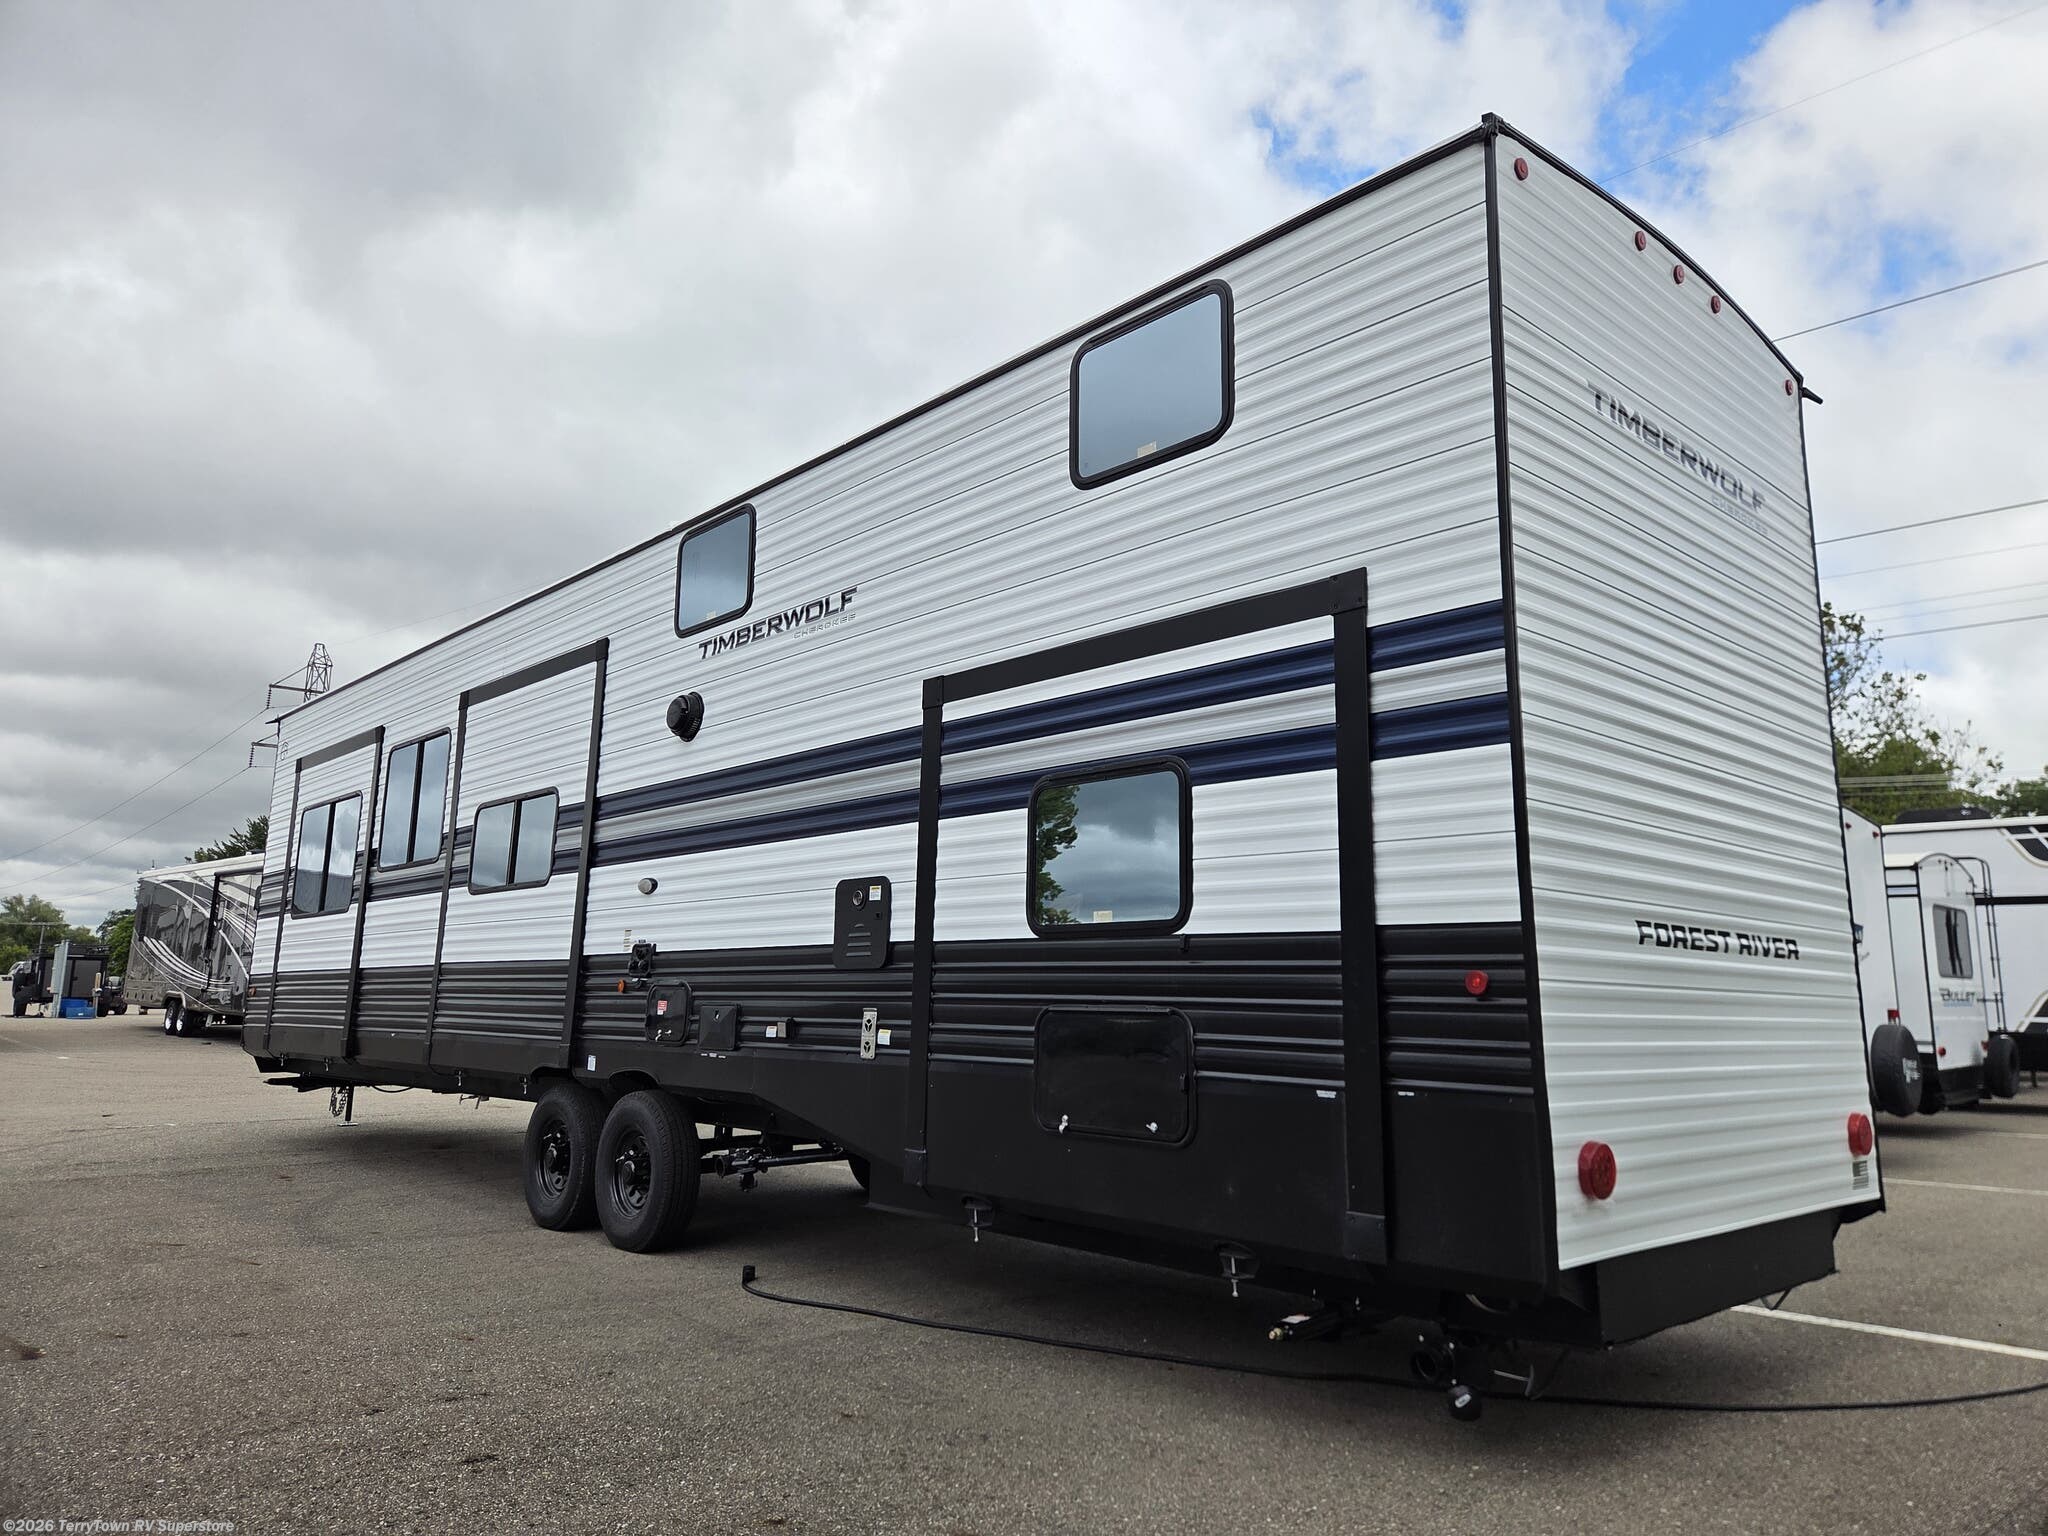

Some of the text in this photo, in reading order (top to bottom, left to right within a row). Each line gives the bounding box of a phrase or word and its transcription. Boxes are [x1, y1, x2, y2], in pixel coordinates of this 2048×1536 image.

[1586, 379, 1766, 513] TIMBERWOLF
[699, 587, 858, 660] TIMBERWOLF
[793, 613, 857, 639] CHEROKEE
[1635, 919, 1800, 961] FOREST RIVER
